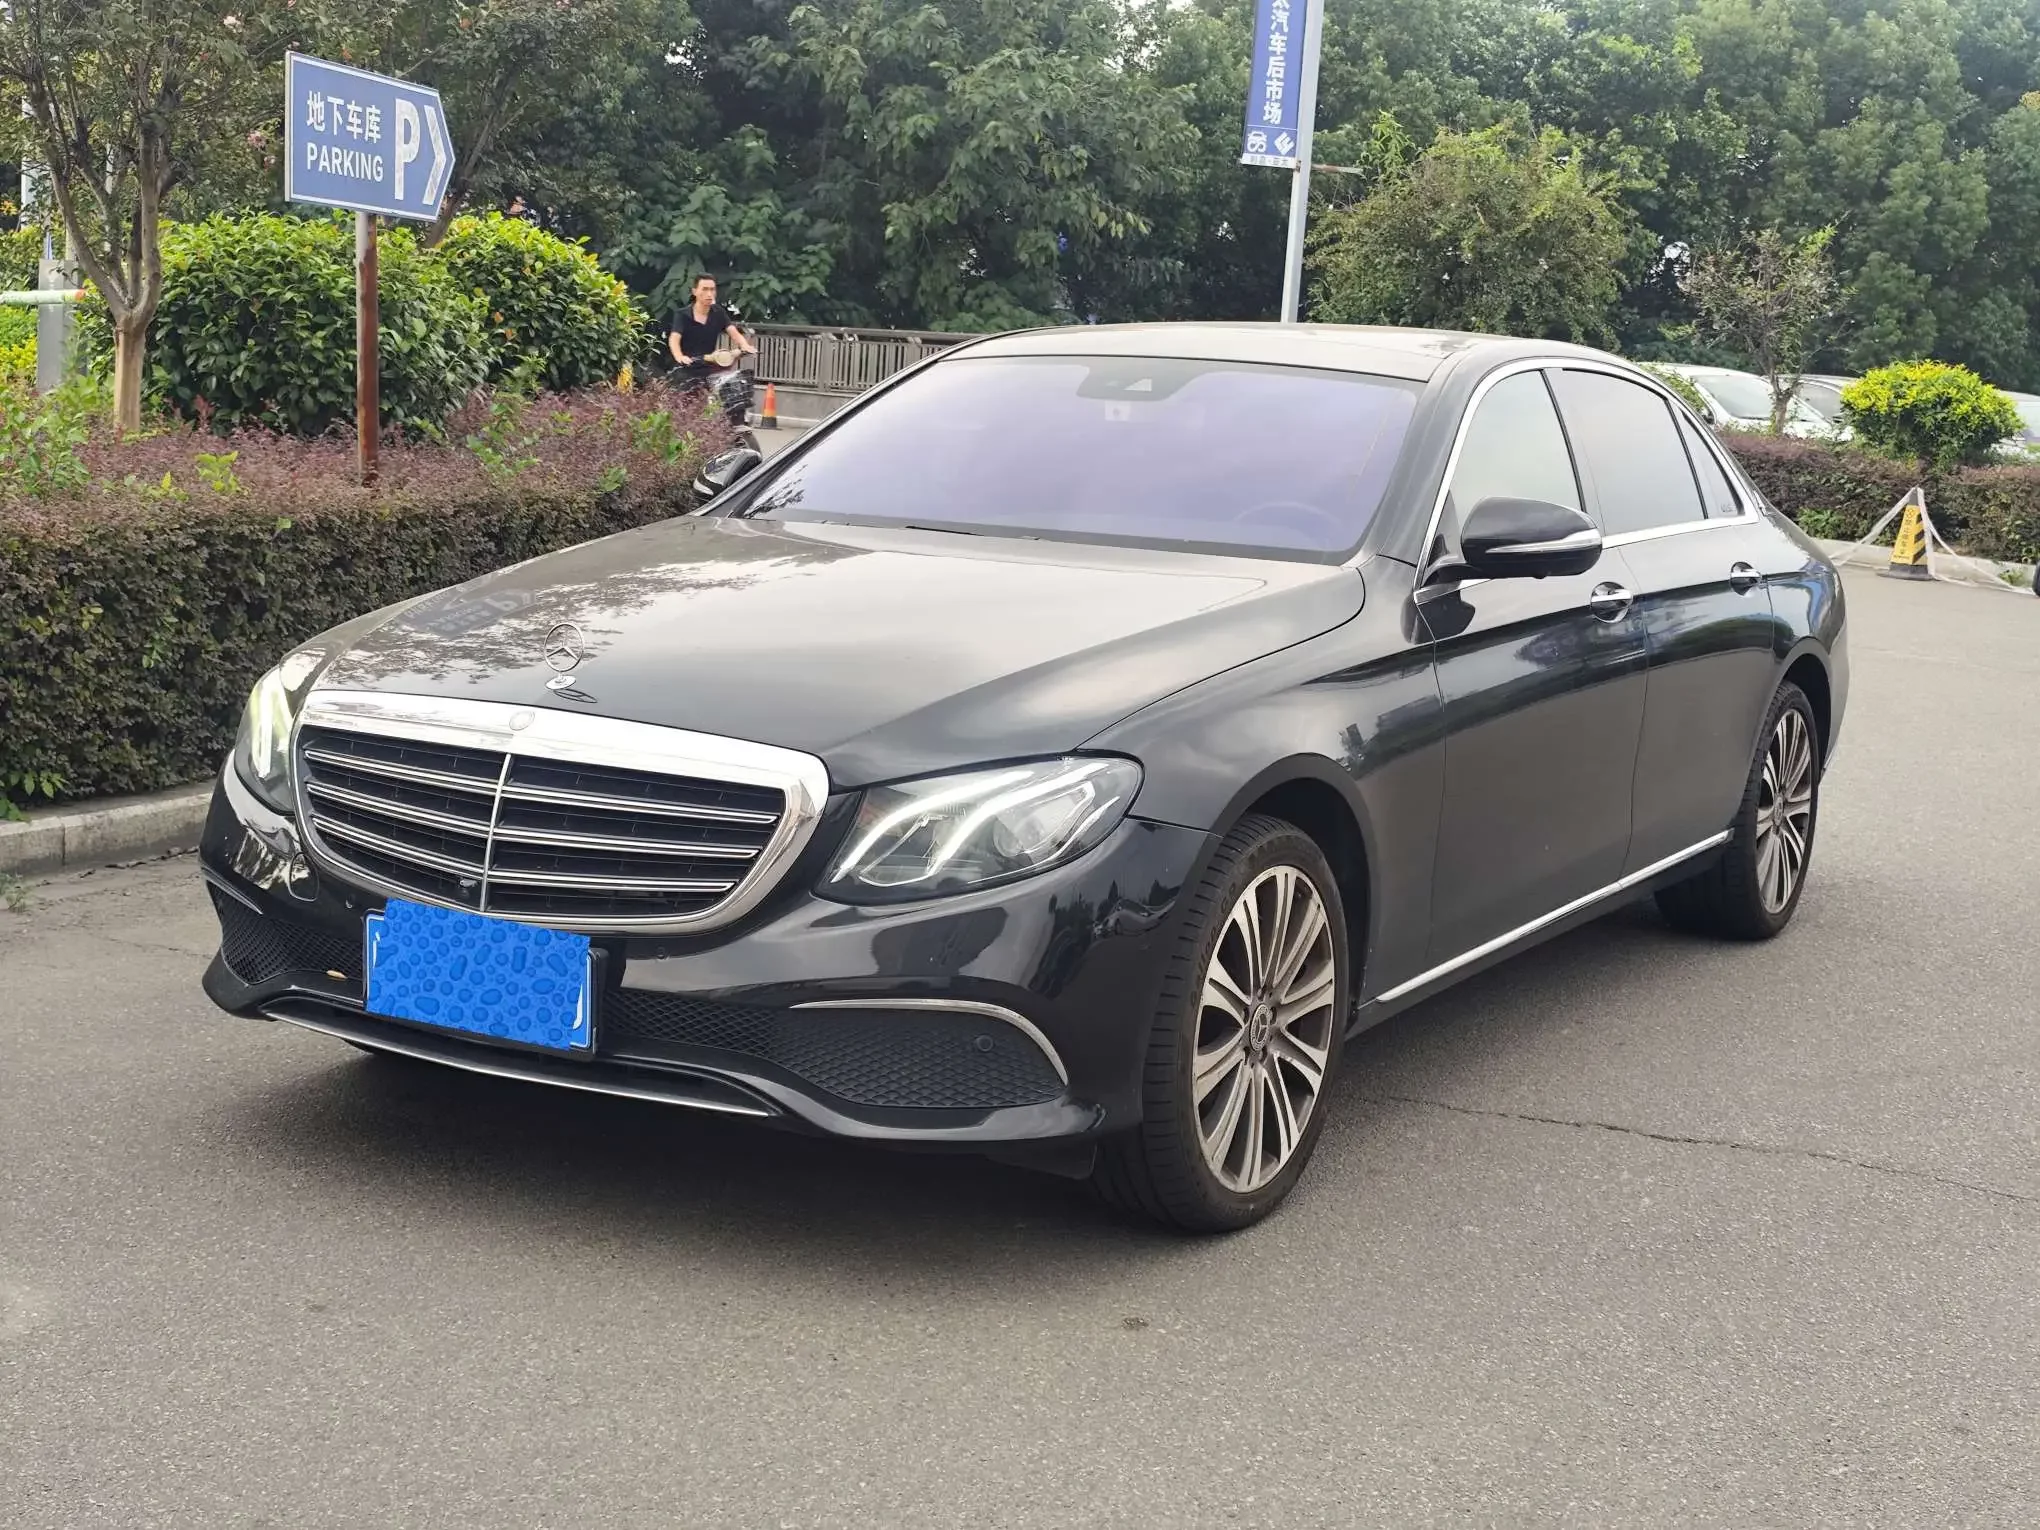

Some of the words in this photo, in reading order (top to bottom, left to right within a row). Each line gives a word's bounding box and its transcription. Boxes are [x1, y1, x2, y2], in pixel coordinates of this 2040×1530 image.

[306, 90, 381, 143] 地下车库
[306, 142, 383, 182] PARKING
[394, 98, 420, 200] P
